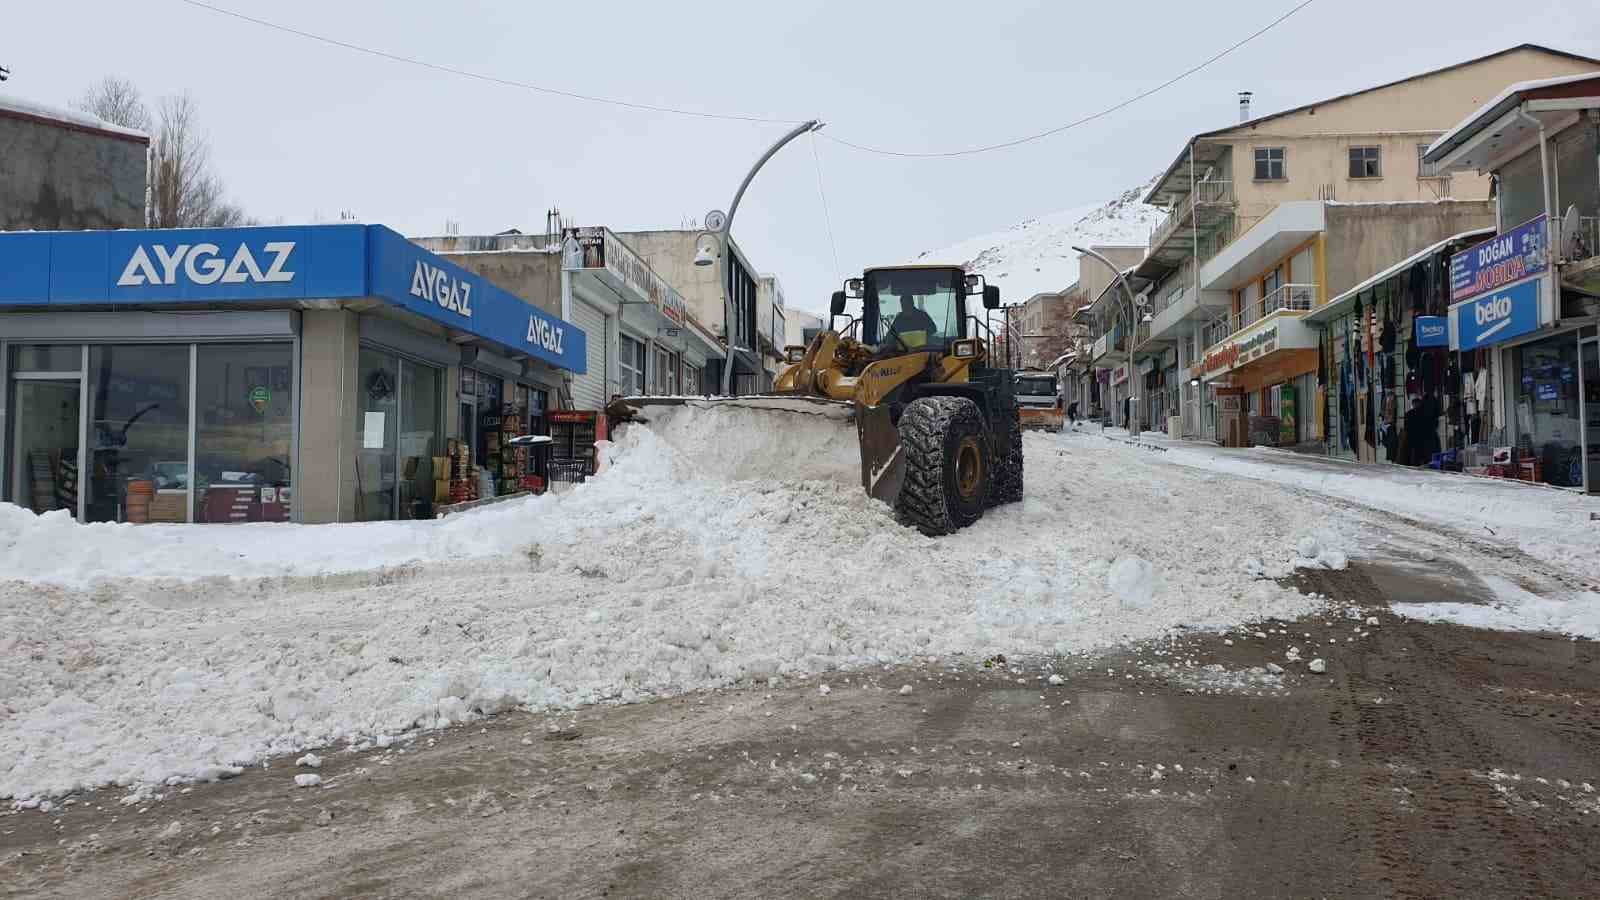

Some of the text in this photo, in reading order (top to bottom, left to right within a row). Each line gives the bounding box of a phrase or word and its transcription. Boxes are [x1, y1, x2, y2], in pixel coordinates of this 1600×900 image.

[117, 241, 296, 286] AYGAZ
[1479, 236, 1513, 267] DOĞAN
[410, 259, 472, 317] AYGAZ
[1475, 295, 1512, 326] beko
[526, 312, 564, 355] AYGAZ
